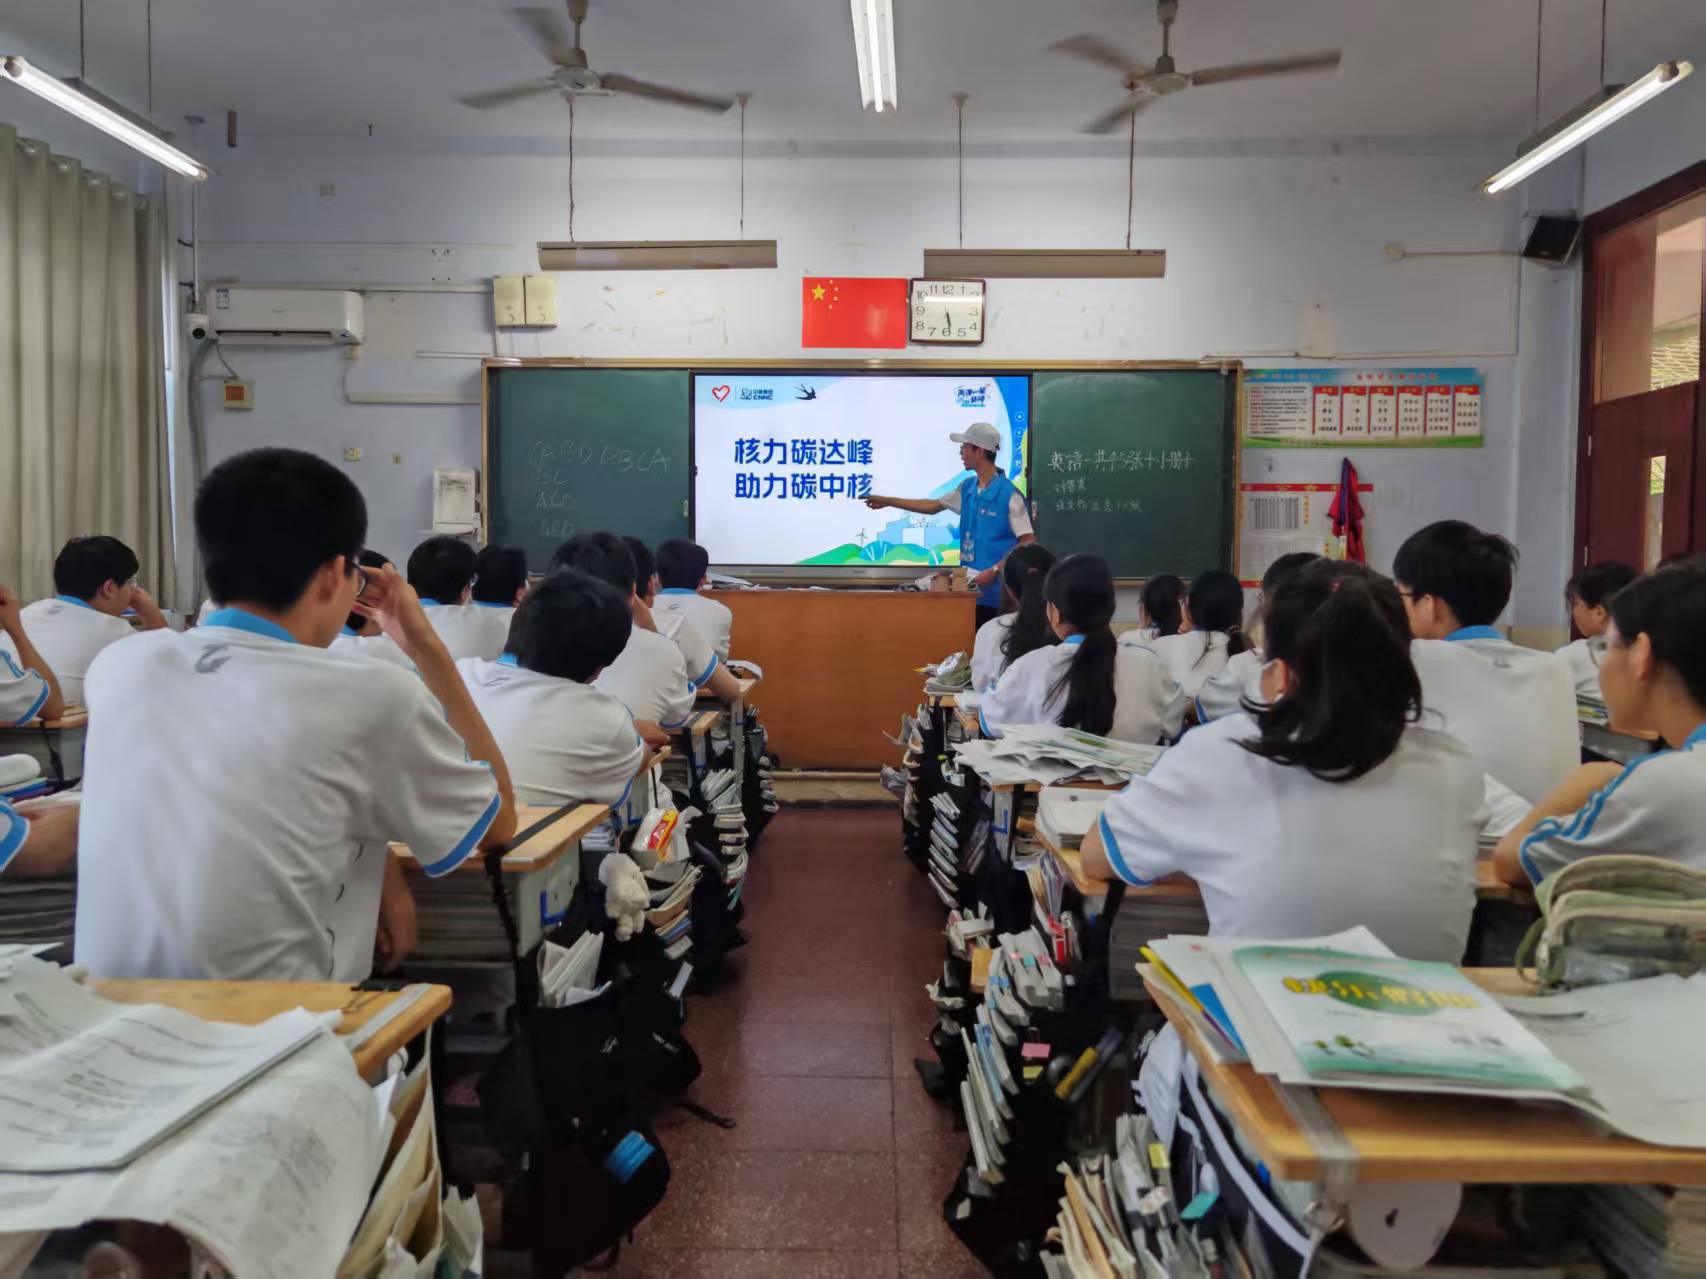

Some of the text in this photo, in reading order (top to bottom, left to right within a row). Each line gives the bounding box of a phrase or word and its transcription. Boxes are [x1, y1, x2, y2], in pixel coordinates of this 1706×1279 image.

[929, 284, 938, 294] 11
[942, 284, 954, 296] 12
[916, 306, 925, 315] 9
[969, 307, 978, 316] 3
[915, 321, 925, 331] 8
[968, 322, 978, 331] 4
[928, 327, 937, 337] 7
[941, 327, 952, 337] 6
[957, 327, 967, 337] 5
[734, 438, 873, 465] 核力碳达峰
[734, 472, 873, 499] 助力碳中核
